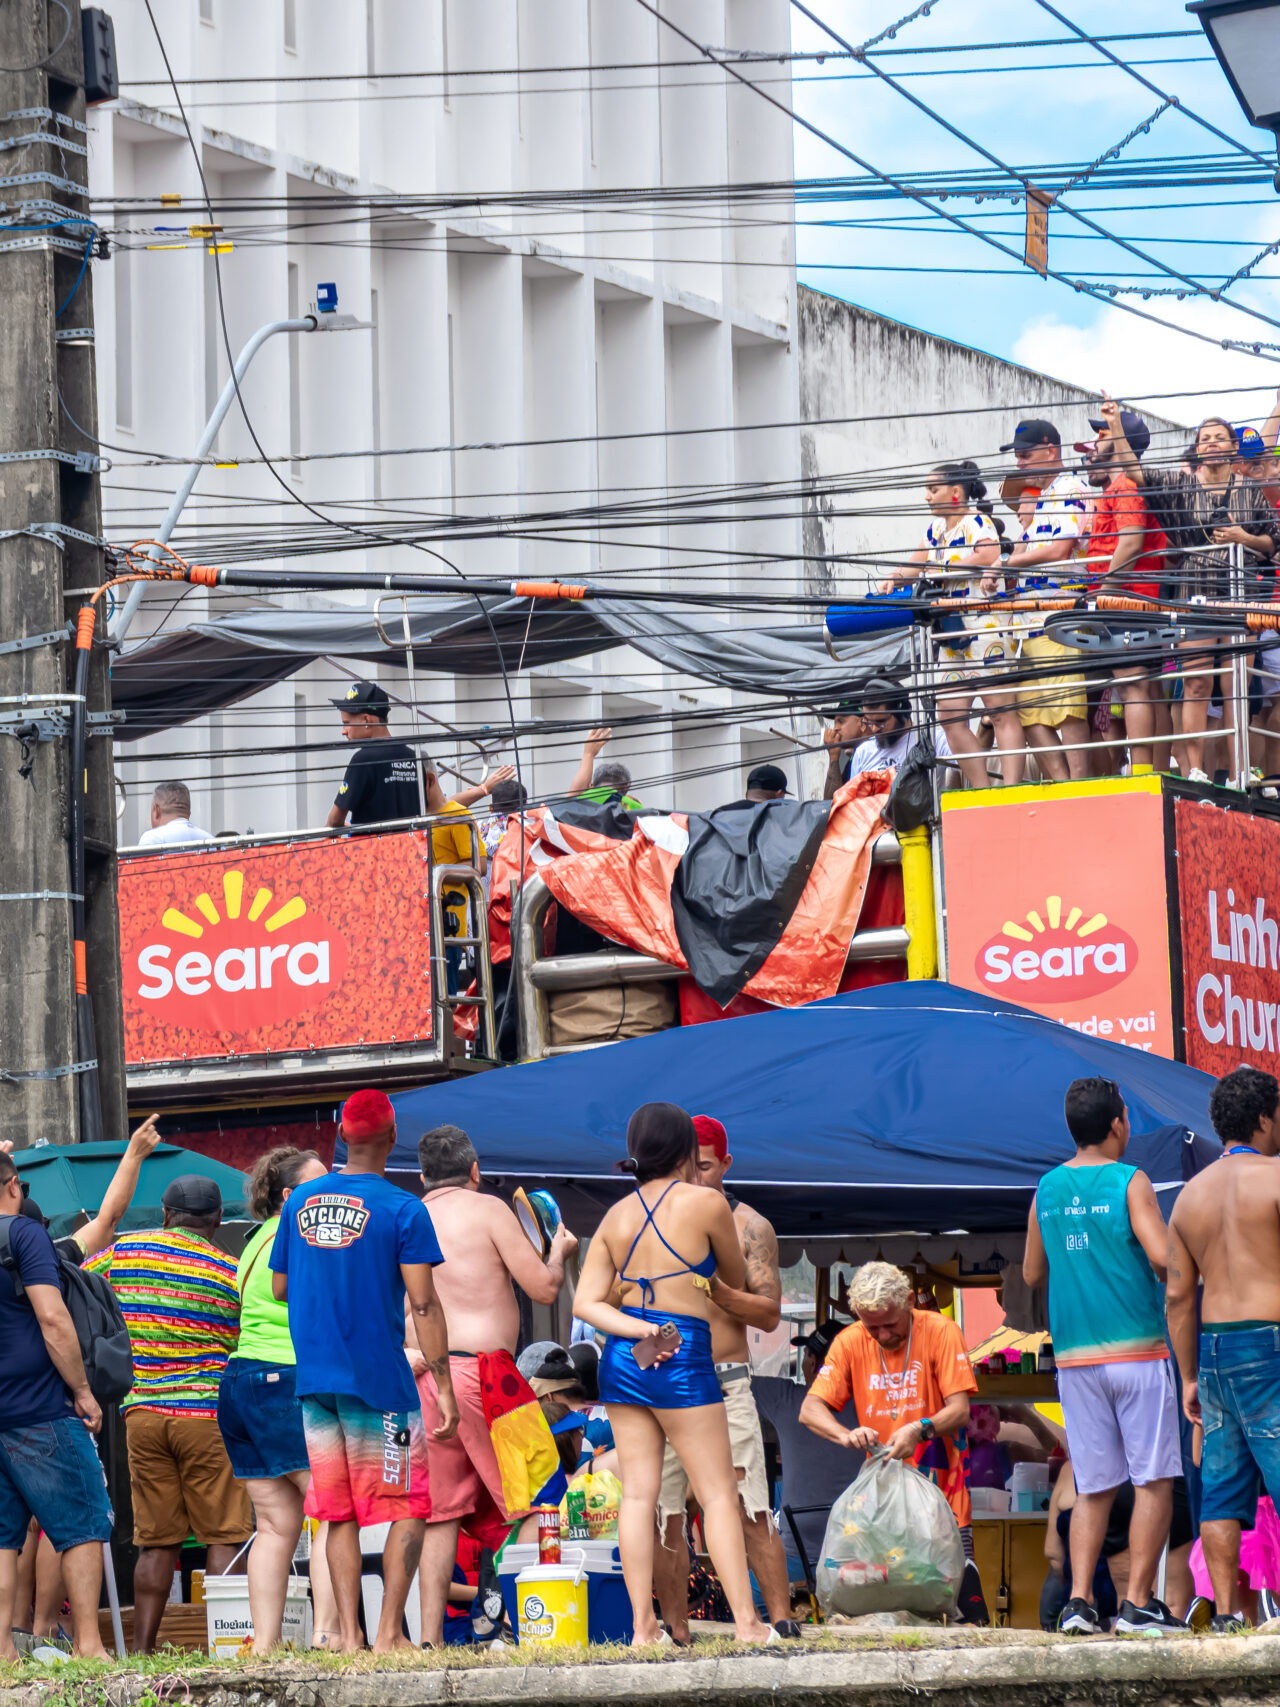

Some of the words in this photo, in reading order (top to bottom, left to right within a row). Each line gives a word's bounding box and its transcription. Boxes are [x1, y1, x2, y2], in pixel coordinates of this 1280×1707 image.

[1208, 888, 1280, 971] Linh
[137, 940, 330, 999] Seara
[983, 942, 1127, 983] Seara
[1120, 1011, 1155, 1034] vai
[300, 1206, 365, 1230] CYCLONE
[869, 1369, 918, 1390] RECIFE
[382, 1411, 401, 1487] SEAWAY
